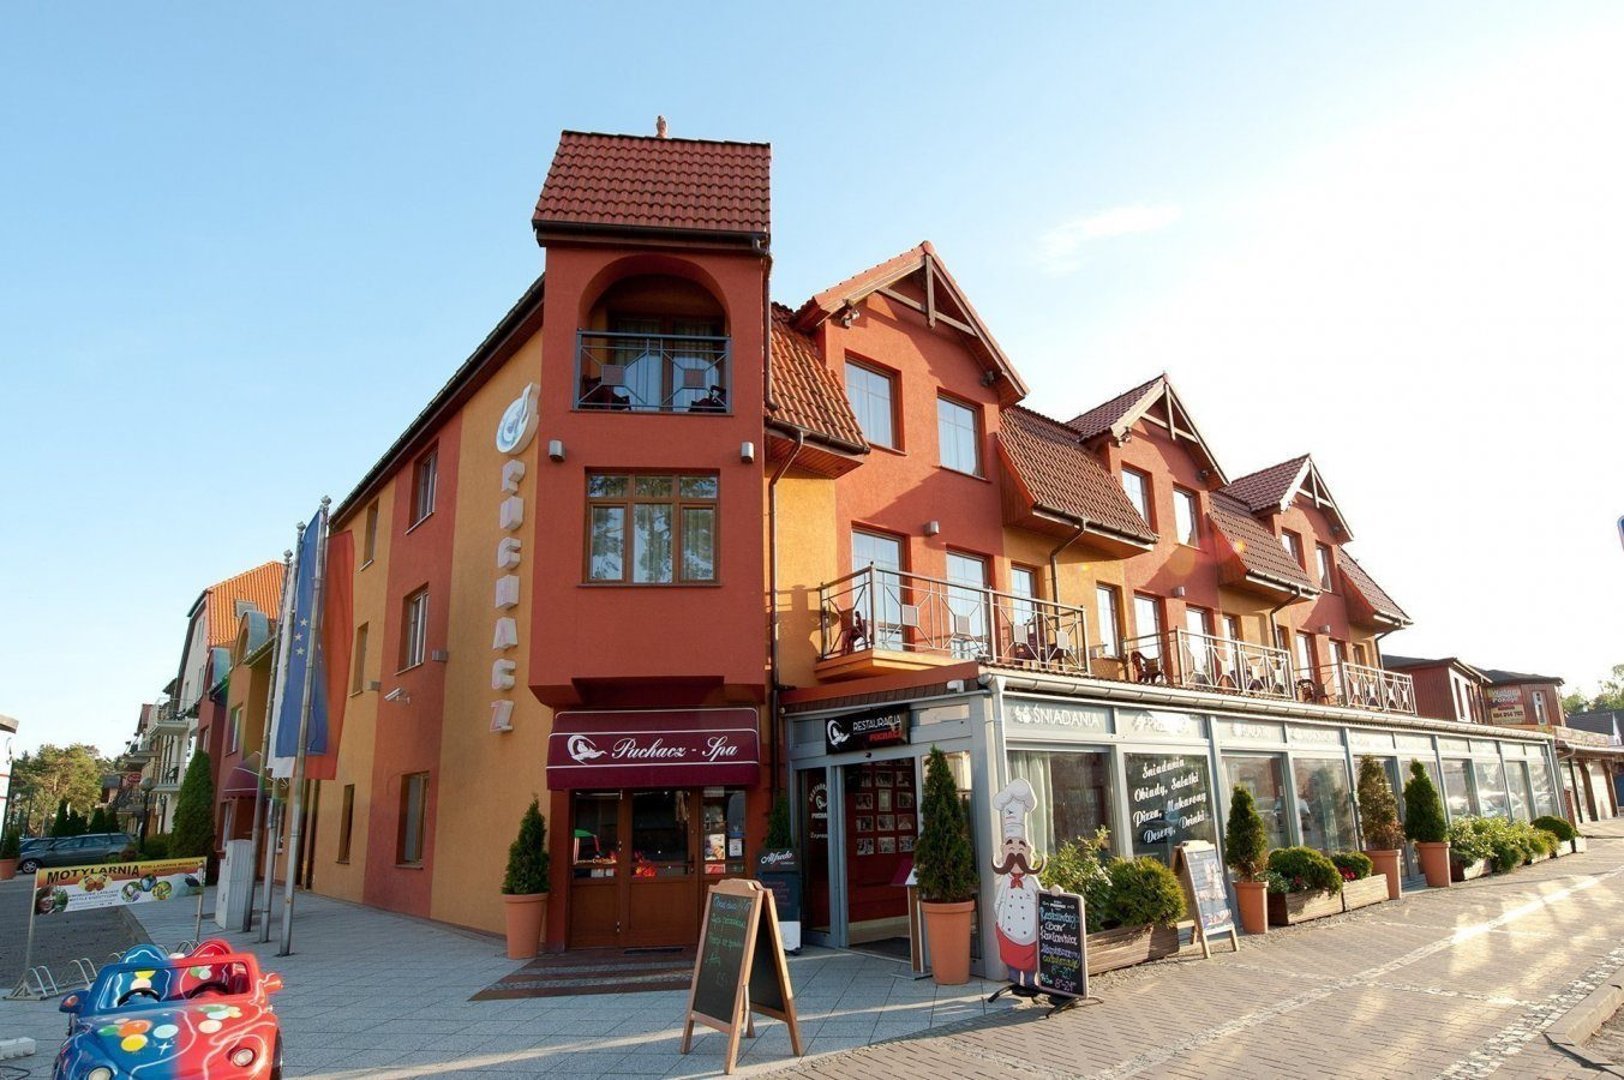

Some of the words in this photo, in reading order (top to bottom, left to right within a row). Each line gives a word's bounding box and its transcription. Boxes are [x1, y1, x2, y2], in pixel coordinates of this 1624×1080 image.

[853, 714, 901, 731] RESTAURACJA
[1033, 704, 1101, 728] ŚNIADANIA
[611, 738, 687, 759] Puchacz
[701, 735, 738, 762] Spa
[1142, 756, 1185, 779] Śniadania
[1134, 783, 1168, 802] Obiady,
[1133, 809, 1162, 828] Pizza,
[1179, 810, 1205, 829] Drinki
[760, 850, 793, 863] Alfredo
[47, 864, 140, 885] MOTYLARNIA
